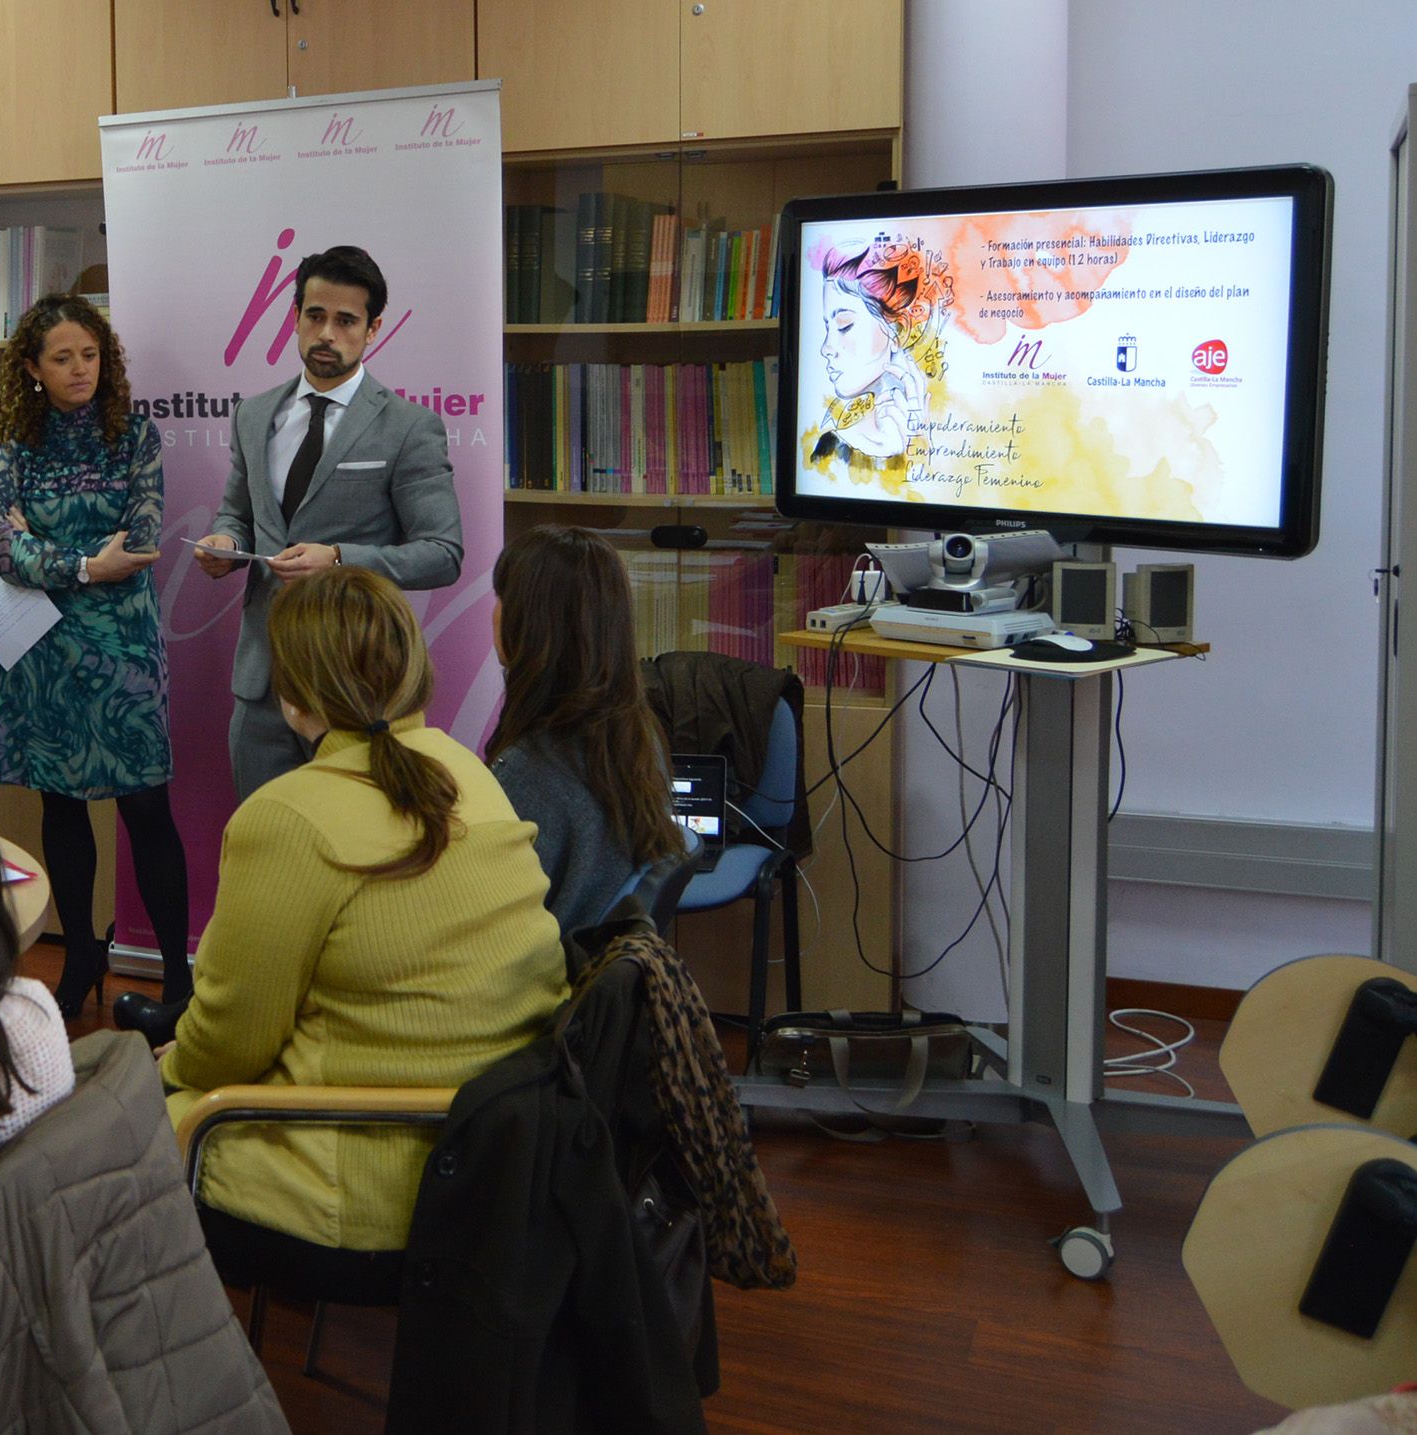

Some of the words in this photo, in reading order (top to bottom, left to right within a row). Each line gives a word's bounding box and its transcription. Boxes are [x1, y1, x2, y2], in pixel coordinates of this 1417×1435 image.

[395, 141, 431, 151] Instituto
[433, 140, 443, 148] de
[445, 139, 453, 147] la
[456, 138, 482, 148] Mujer
[297, 149, 331, 159] Instituto
[333, 148, 343, 156] de
[345, 147, 353, 155] la
[355, 146, 378, 155] Mujer
[204, 157, 236, 166] Instituto
[238, 156, 248, 164] de
[258, 153, 281, 162] Mujer
[116, 164, 145, 173] Instituto
[146, 163, 156, 171] de
[157, 162, 165, 170] la
[167, 161, 188, 170] Mujer
[987, 238, 1034, 251] Formación
[1036, 237, 1086, 252] presencial:
[1089, 235, 1143, 248] Habilidades
[1204, 231, 1255, 245] Liderazgo
[980, 260, 986, 270] y
[989, 257, 1021, 269] Trabajo
[1023, 258, 1034, 267] en
[1036, 257, 1066, 269] equipo
[1087, 252, 1118, 265] horas)
[986, 290, 1054, 302] Asesoramiento
[1056, 291, 1063, 302] y
[1065, 288, 1146, 302] acompañamiento
[1149, 289, 1161, 299] en
[1164, 286, 1173, 299] el
[1175, 286, 1206, 298] diseño
[1209, 284, 1224, 298] del
[1226, 284, 1250, 300] plan
[979, 308, 988, 318] de
[990, 307, 1024, 320] negocio
[1193, 346, 1226, 369] aje
[982, 371, 1017, 379] Instituto
[1019, 371, 1029, 379] de
[1032, 371, 1039, 379] la
[1042, 372, 1067, 381] Mujer
[1134, 377, 1166, 388] Mancha
[907, 409, 1025, 440] Empoderamiento
[906, 435, 1021, 466] Emprendimiento
[902, 460, 972, 497] Liderazgo
[974, 464, 1044, 488] Femenino
[996, 519, 1026, 528] PHILIPS
